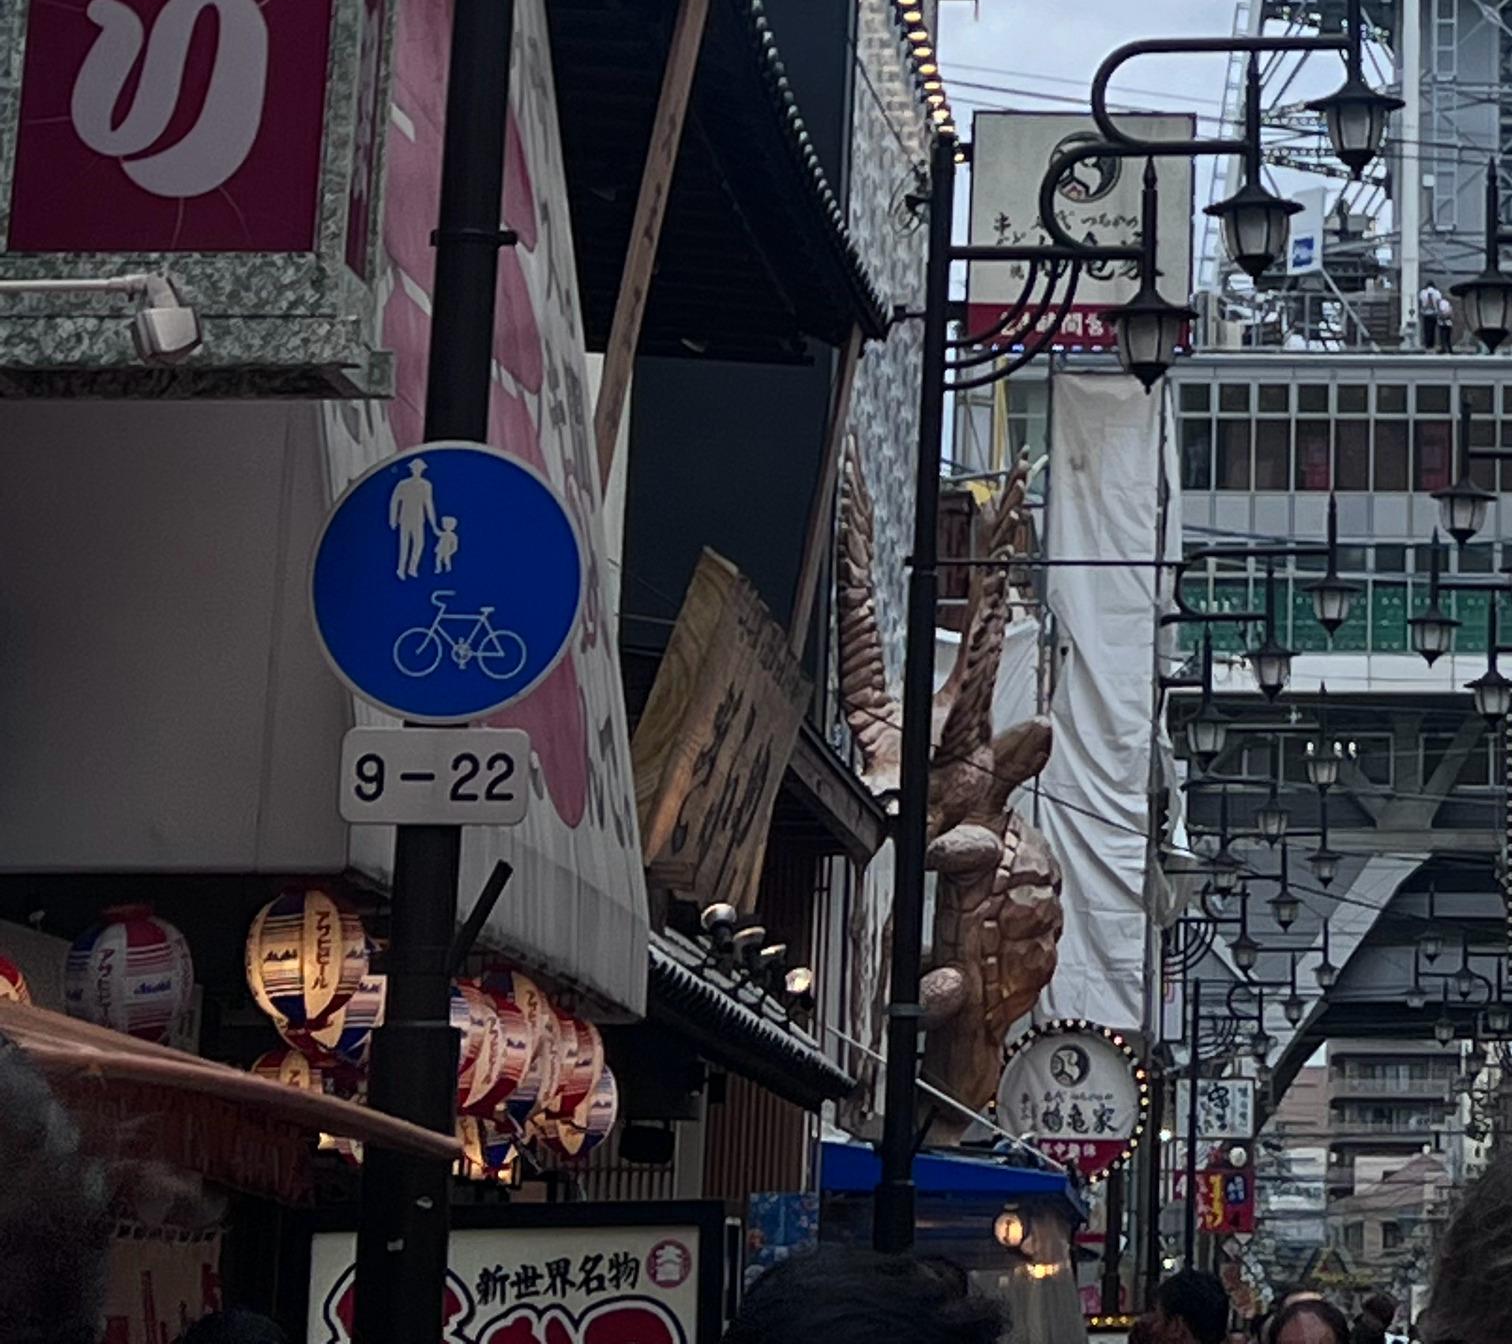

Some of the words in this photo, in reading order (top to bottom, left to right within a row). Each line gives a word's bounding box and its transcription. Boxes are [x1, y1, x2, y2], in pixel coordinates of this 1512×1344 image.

[476, 1251, 641, 1305] 新世界名物
